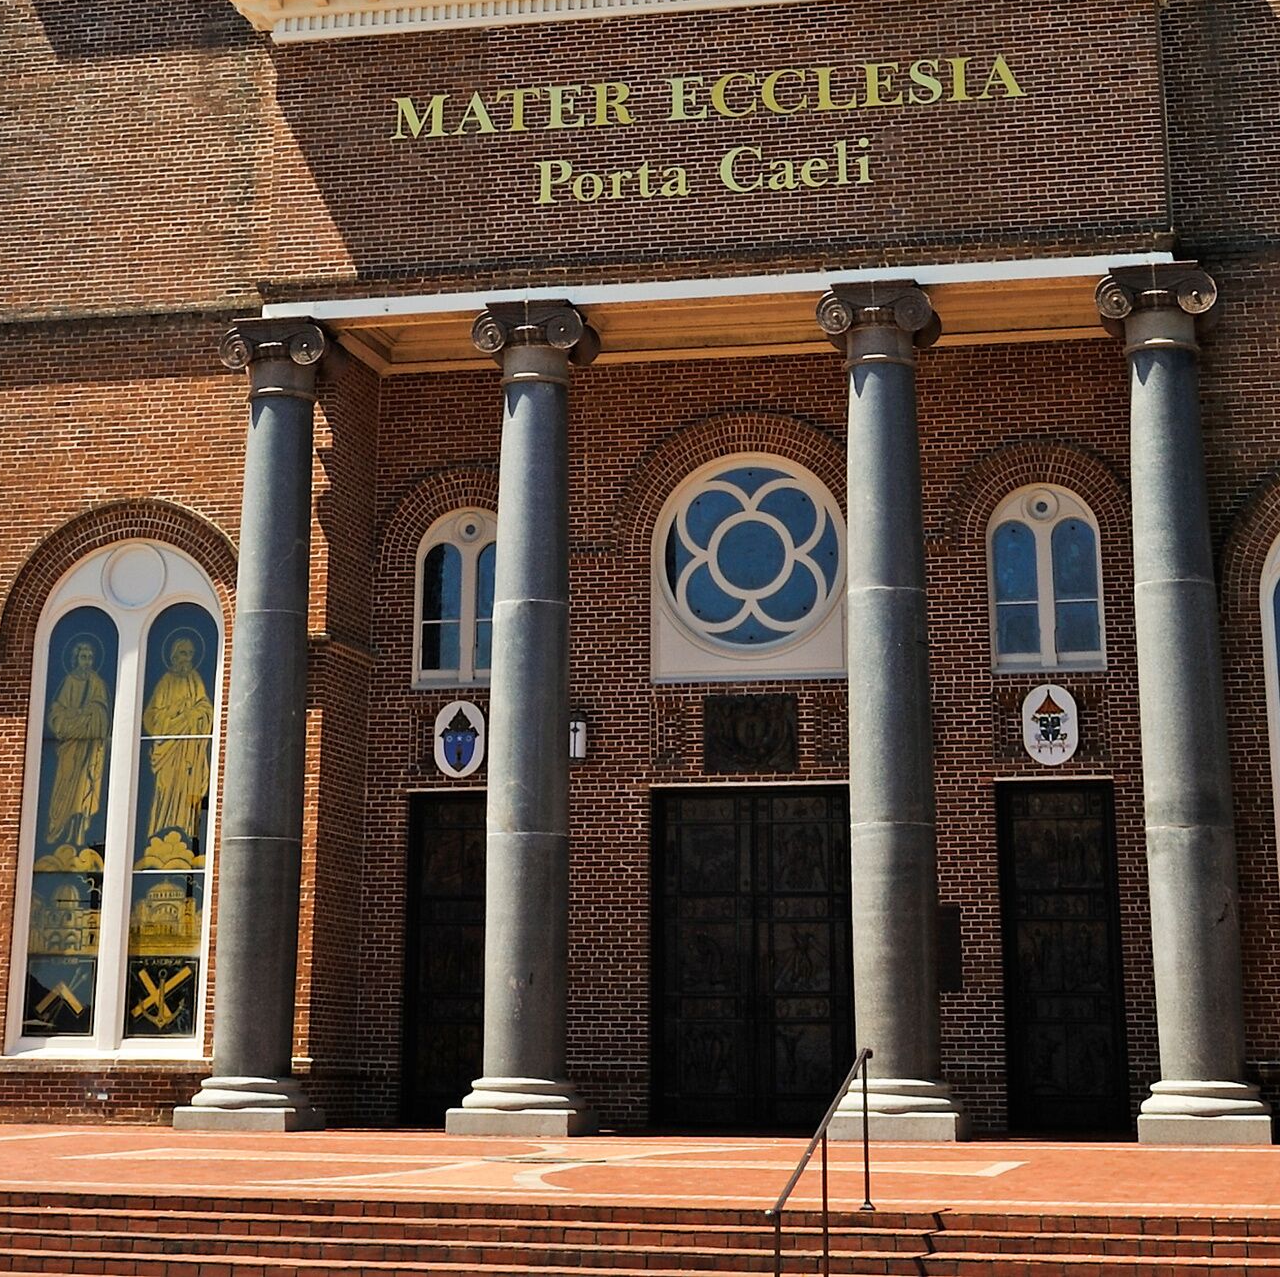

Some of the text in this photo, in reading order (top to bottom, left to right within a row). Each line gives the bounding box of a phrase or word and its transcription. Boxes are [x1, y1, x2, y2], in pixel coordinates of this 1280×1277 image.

[389, 53, 1027, 140] MATER ECCLESIA
[534, 137, 875, 206] Porta Caeli
